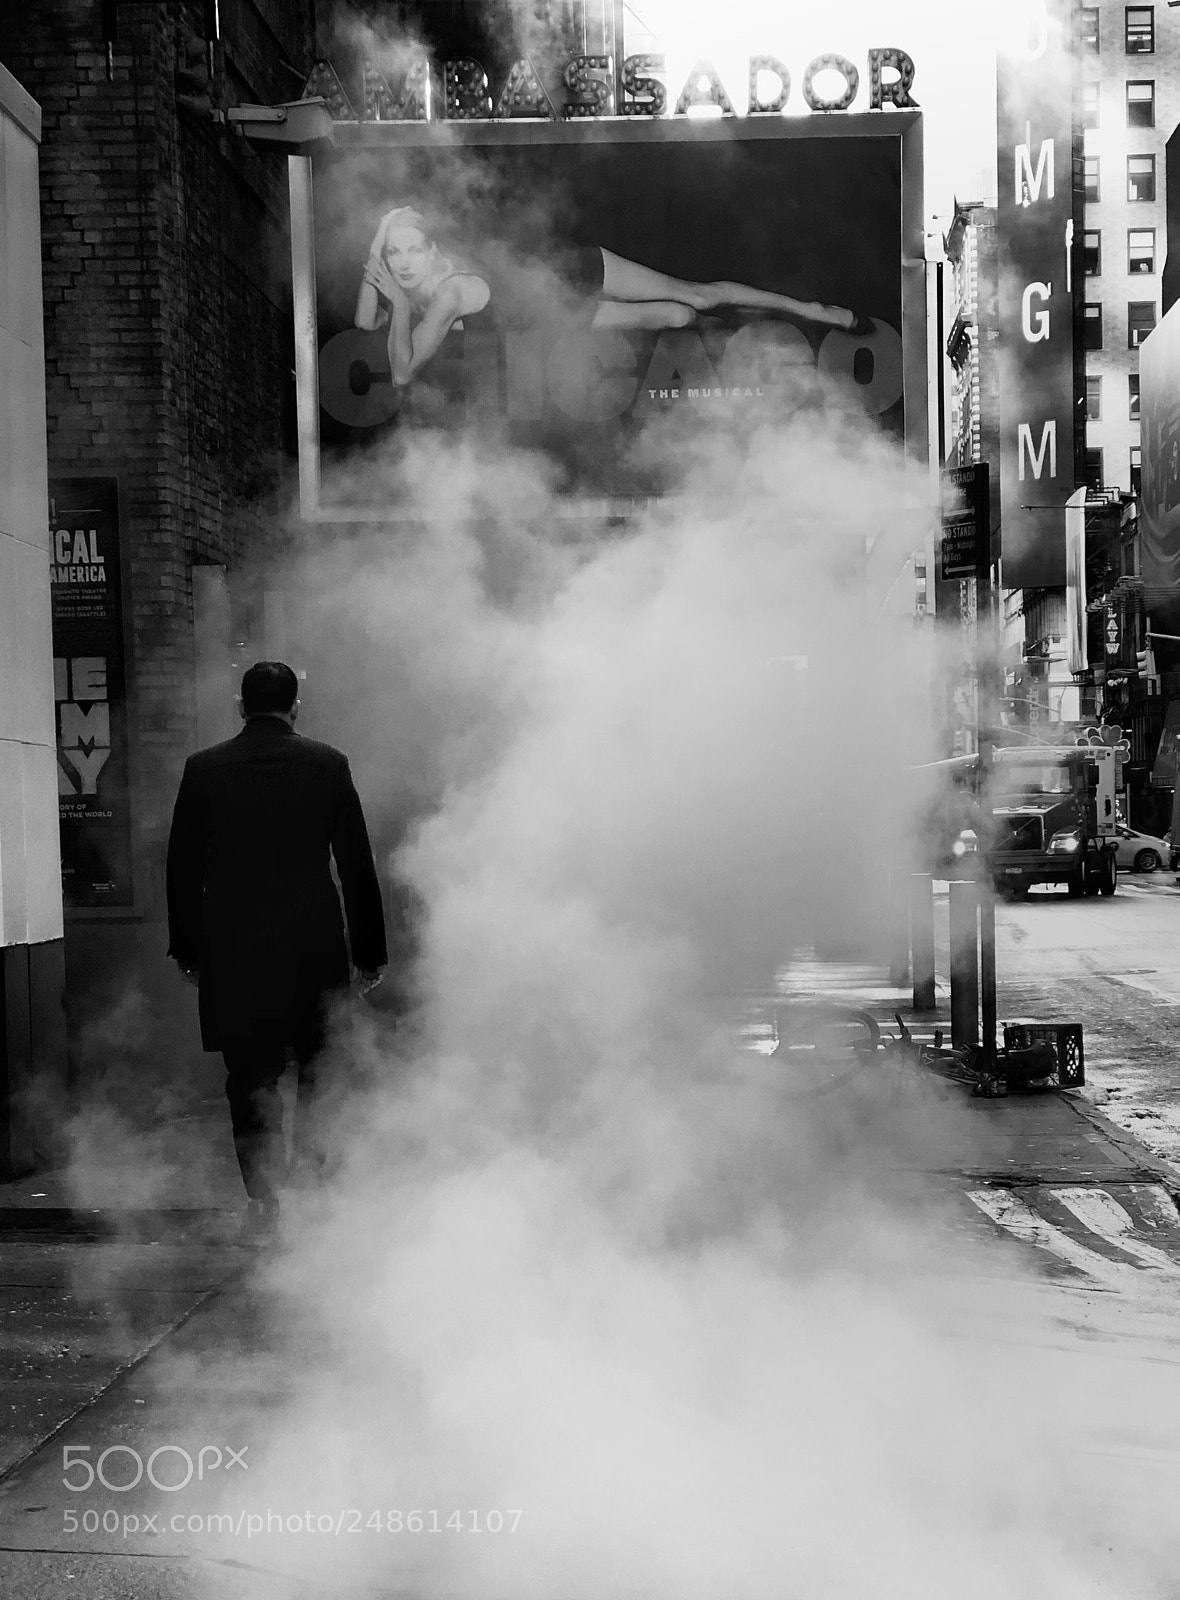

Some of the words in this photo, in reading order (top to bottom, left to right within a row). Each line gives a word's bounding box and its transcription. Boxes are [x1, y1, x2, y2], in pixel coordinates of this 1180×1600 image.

[301, 48, 920, 120] AMBASSADOR
[318, 317, 904, 427] CHICAGO
[648, 388, 680, 399] THE
[687, 387, 765, 399] MUSICAL
[943, 527, 952, 539] NO
[50, 566, 106, 583] AMERICA
[84, 810, 113, 818] WORLD
